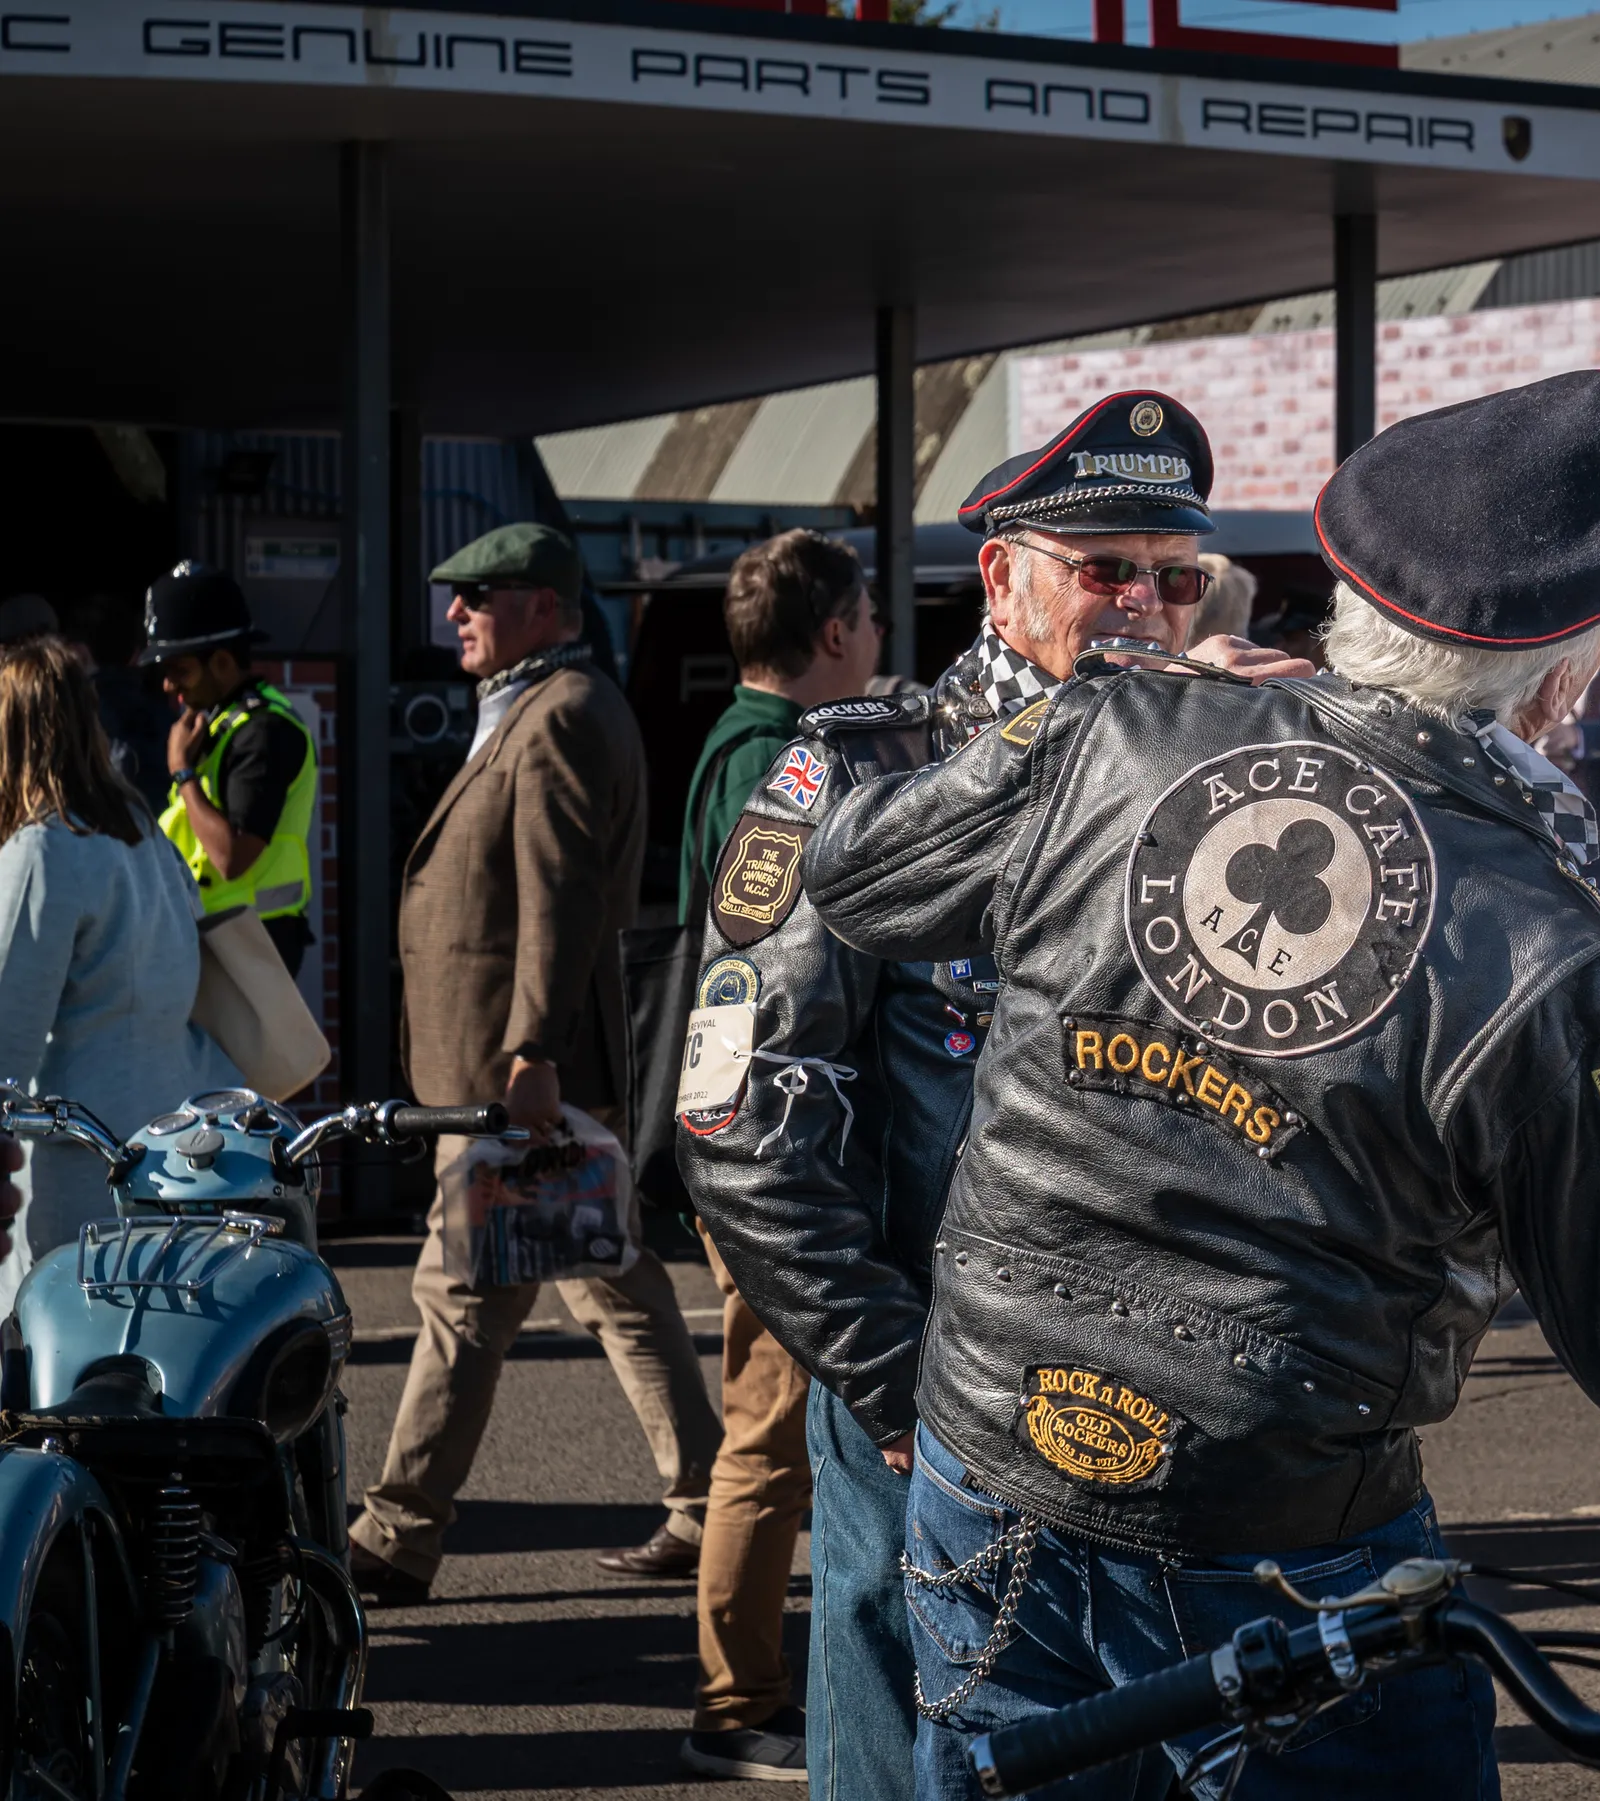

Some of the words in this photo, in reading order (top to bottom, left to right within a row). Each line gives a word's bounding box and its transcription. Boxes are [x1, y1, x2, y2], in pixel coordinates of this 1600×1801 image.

[142, 19, 573, 78] GENUINE
[631, 47, 930, 106] PARTS
[985, 78, 1150, 124] AND
[1201, 97, 1475, 152] REPAIR
[1067, 450, 1191, 484] TRIUMPH
[805, 701, 890, 725] ROCKERS
[1202, 757, 1325, 814] ACE
[1344, 784, 1420, 927] CAFE
[762, 848, 780, 862] THE
[741, 870, 778, 888] OWNERS
[746, 859, 785, 878] TRIUMPH
[1199, 905, 1292, 977] ACE
[1140, 874, 1349, 1039] LONDON
[707, 960, 746, 983] MOTORCYCLE
[691, 1019, 716, 1031] REVIVAL
[693, 1091, 708, 1100] 2022
[1076, 1030, 1280, 1143] ROCKERS
[1037, 1368, 1100, 1400] ROCK
[1099, 1386, 1114, 1407] n
[1114, 1387, 1170, 1437] ROLL
[1076, 1412, 1112, 1436] OLD
[1053, 1417, 1129, 1458] ROCKERS
[1078, 1453, 1092, 1465] TO
